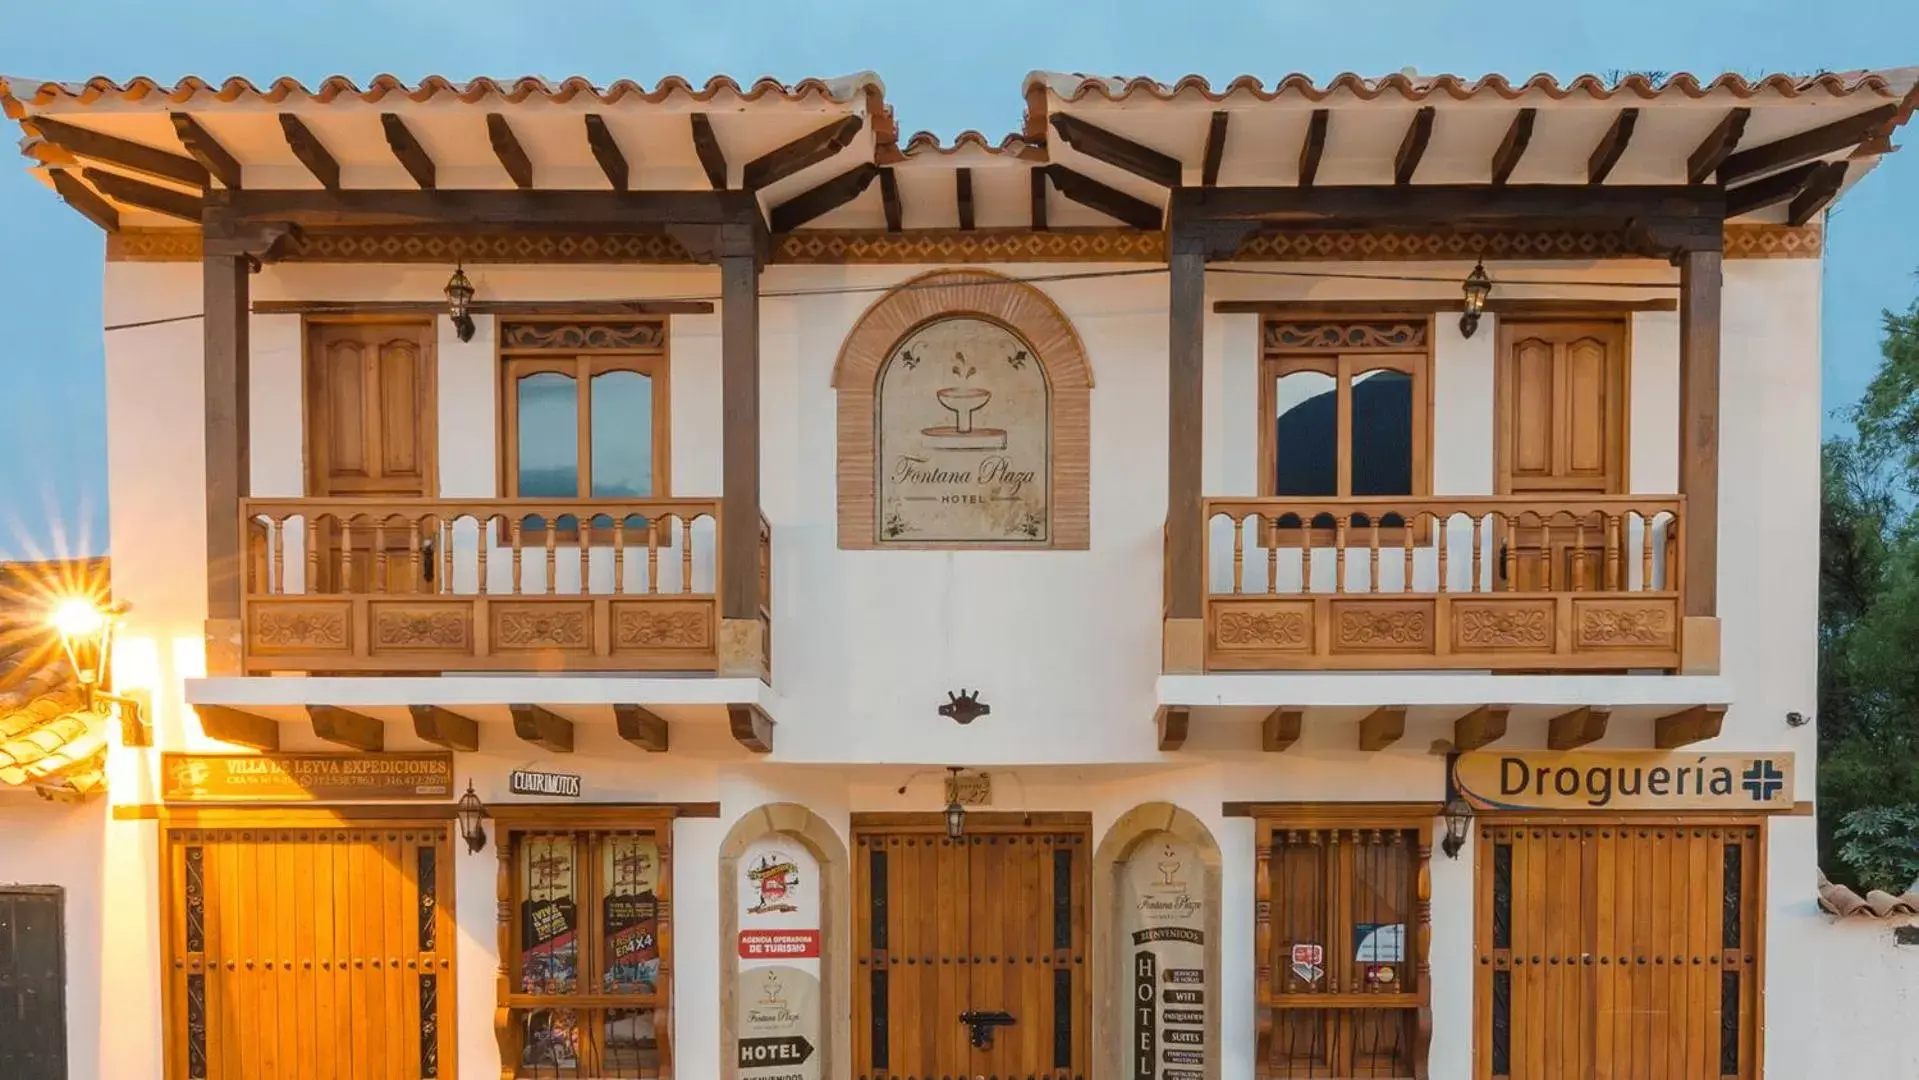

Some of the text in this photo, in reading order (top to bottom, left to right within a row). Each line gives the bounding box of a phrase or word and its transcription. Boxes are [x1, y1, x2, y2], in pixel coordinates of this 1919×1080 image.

[891, 454, 1035, 496] Fontana Plaza
[942, 495, 985, 504] HOTEL
[227, 760, 268, 774] VILLA
[295, 760, 340, 774] LEYVA
[343, 760, 446, 774] EXPEDICIONES
[514, 771, 579, 795] CUATRIMOTOS
[1500, 757, 1732, 806] Droguería
[1136, 895, 1173, 911] Fontana
[742, 936, 812, 944] AGENCIA OPERADORA
[1140, 928, 1199, 941] BIENVENIDOS
[749, 944, 806, 953] DE TURISMO
[1138, 958, 1153, 1076] HOTEL
[1171, 1032, 1200, 1042] SUITES
[741, 1043, 801, 1061] HOTEL
